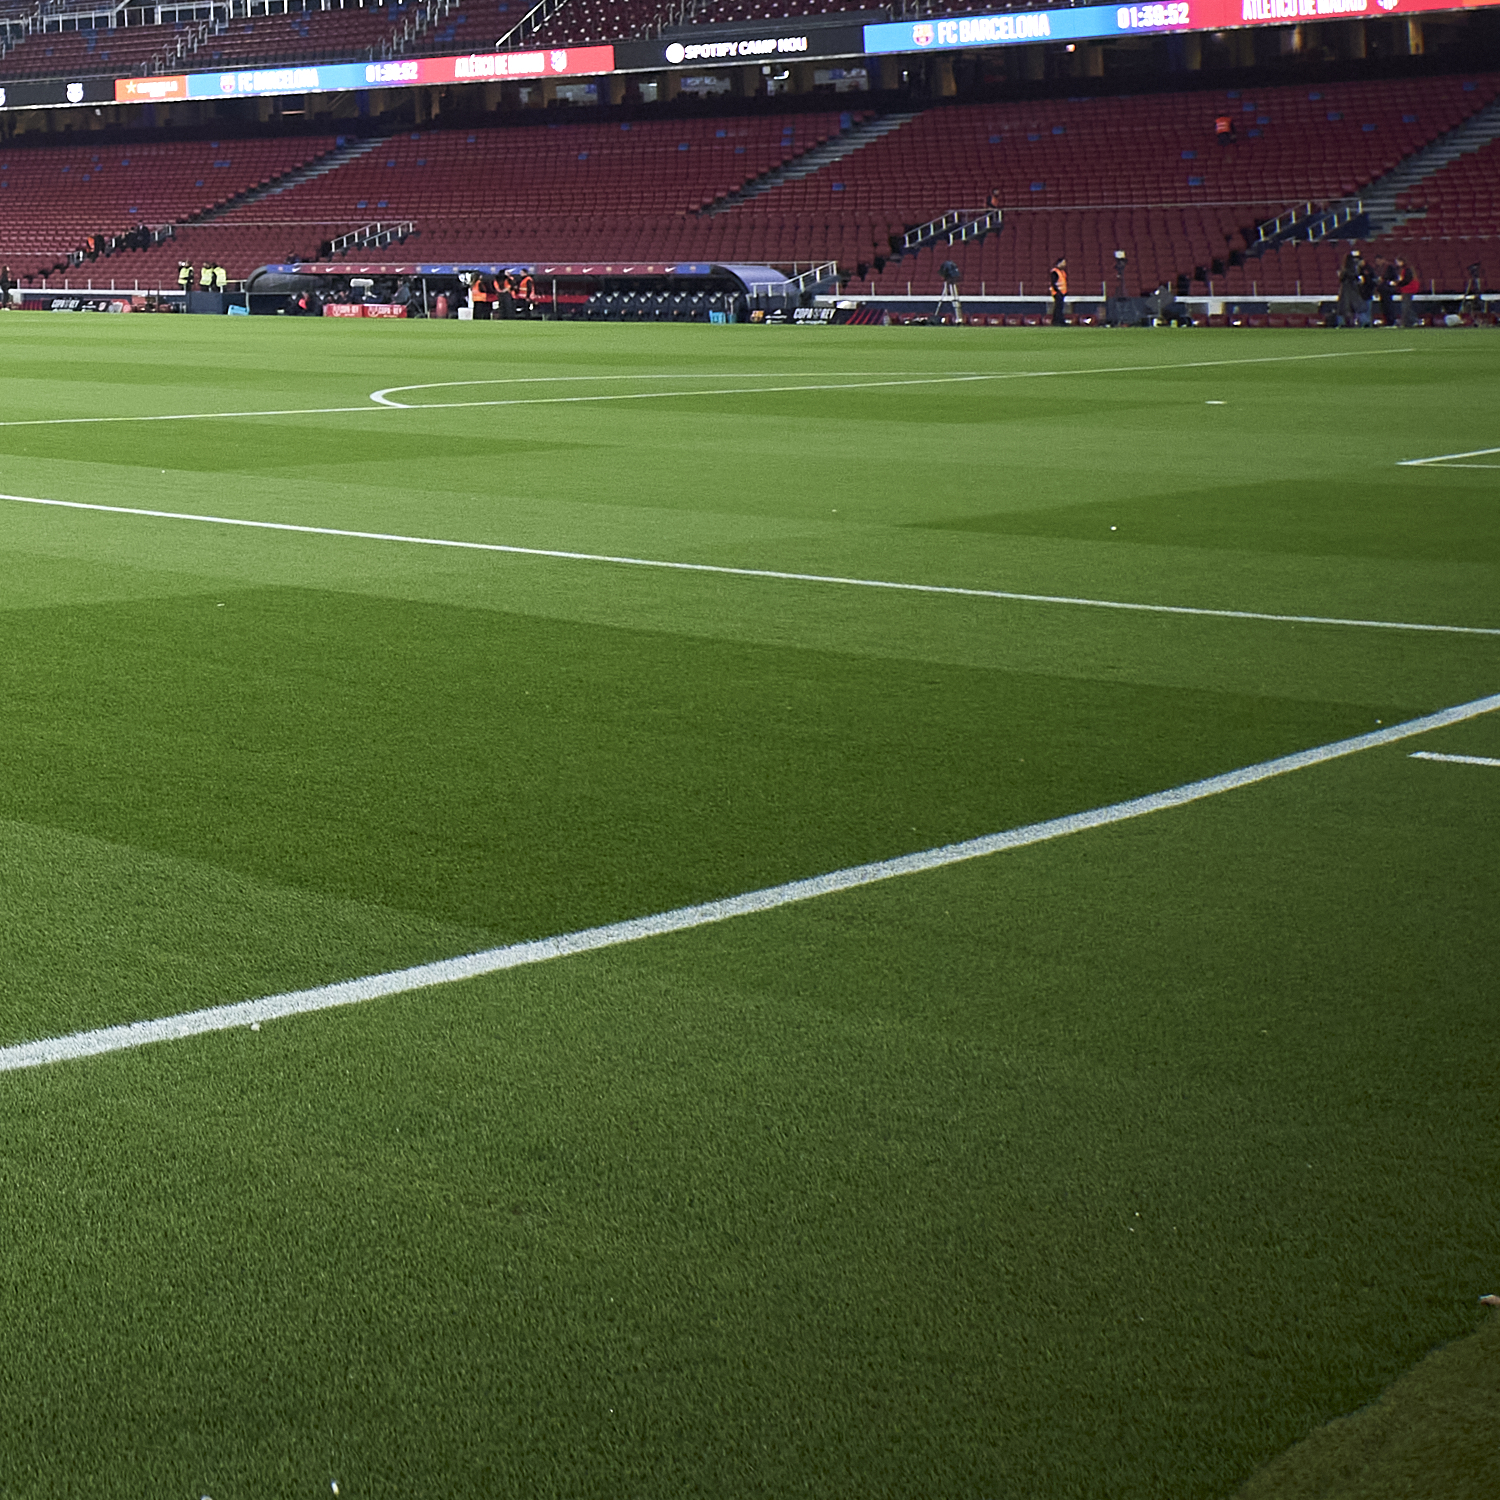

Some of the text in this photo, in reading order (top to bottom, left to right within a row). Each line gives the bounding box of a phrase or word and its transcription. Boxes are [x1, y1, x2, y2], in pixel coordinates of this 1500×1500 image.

[938, 13, 1050, 44] FC BARCELONA
[684, 42, 738, 59] SPOTIFY
[738, 39, 777, 55] CAMP
